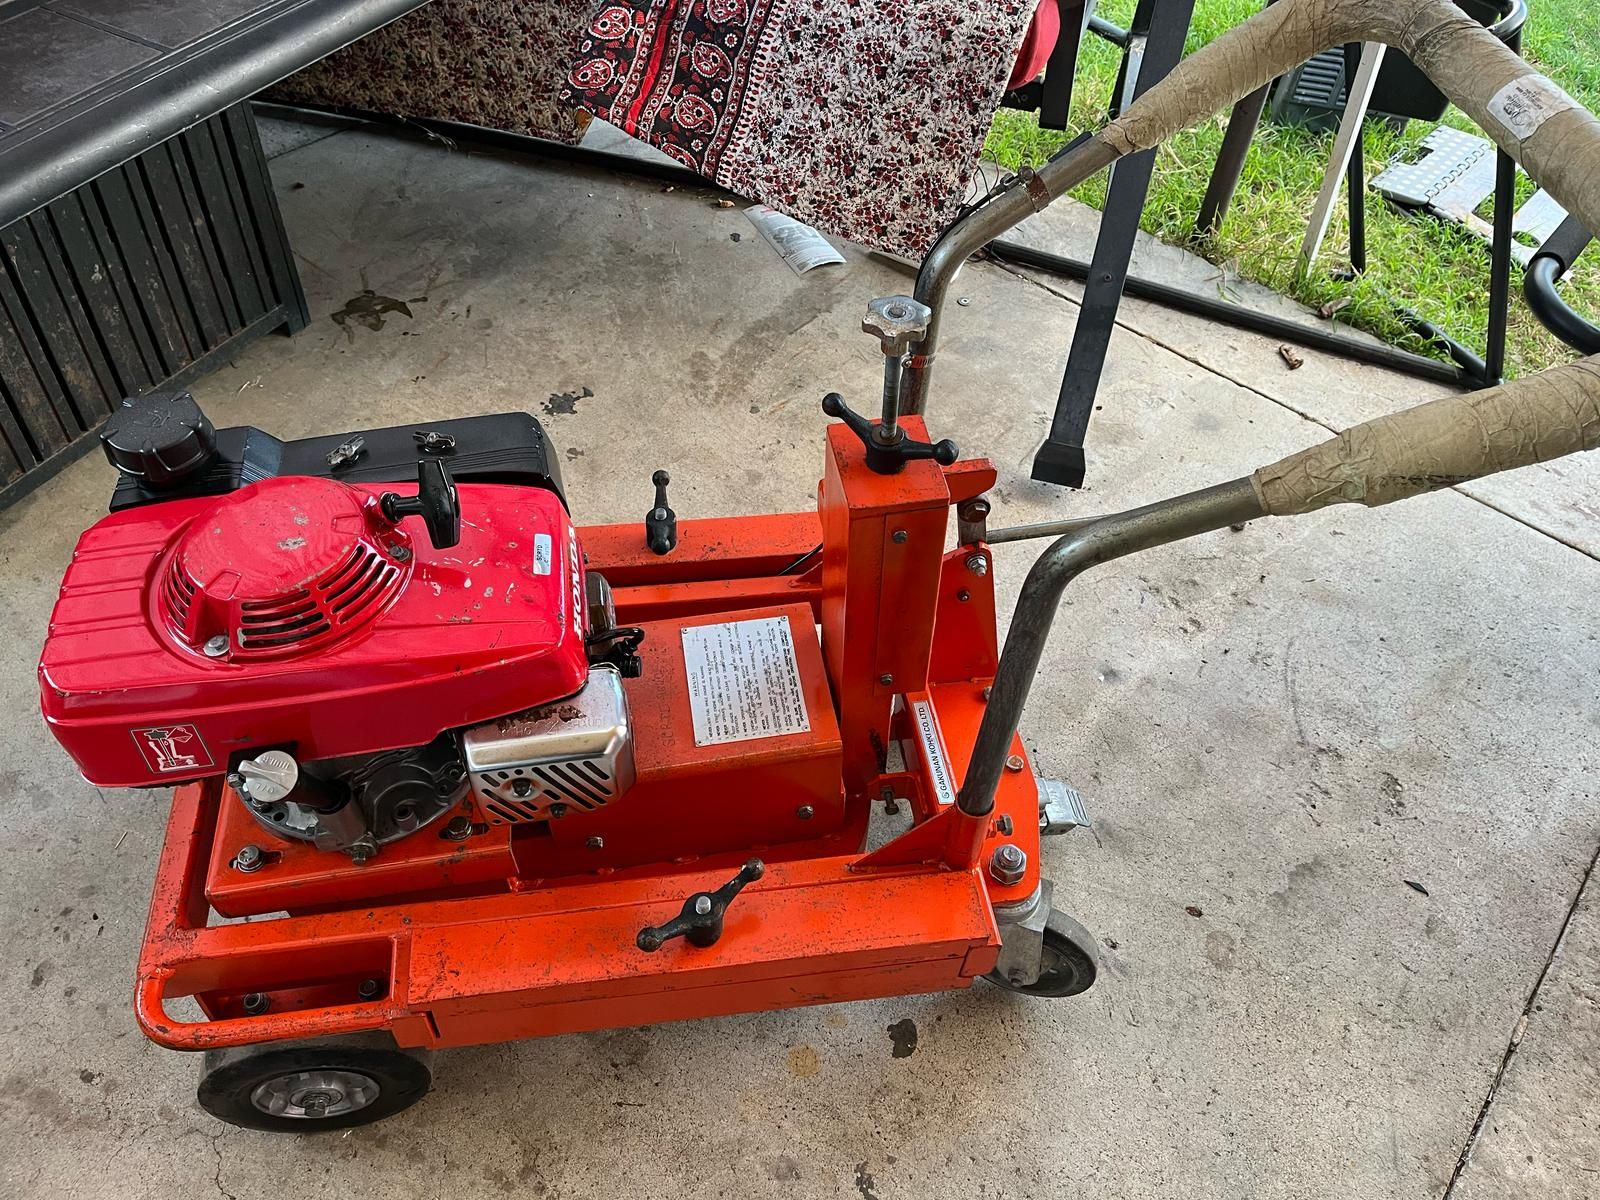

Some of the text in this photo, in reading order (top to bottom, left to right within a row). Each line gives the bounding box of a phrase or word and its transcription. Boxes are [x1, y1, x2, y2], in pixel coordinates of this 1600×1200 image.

[568, 525, 582, 641] HONDA
[925, 733, 937, 755] KOHKI
[932, 755, 948, 791] GAKUNAN
